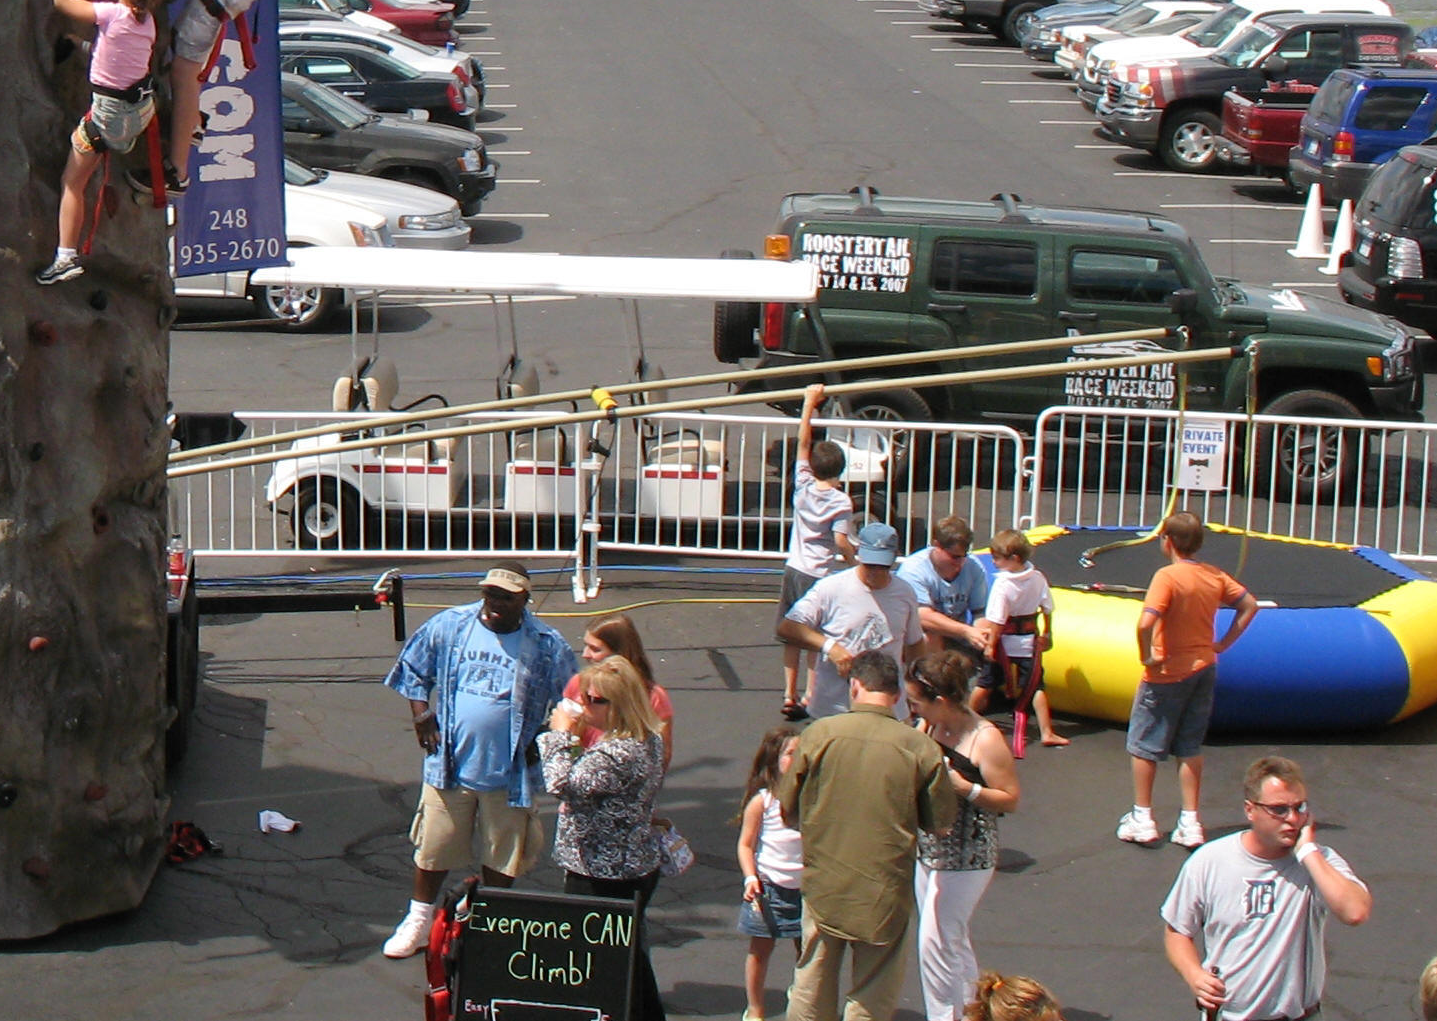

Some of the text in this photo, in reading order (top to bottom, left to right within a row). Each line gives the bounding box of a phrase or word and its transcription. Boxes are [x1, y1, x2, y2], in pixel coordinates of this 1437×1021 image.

[209, 207, 248, 231] 248
[179, 237, 279, 266] 935-2670
[802, 232, 911, 258] ROOSTERTAIL
[842, 255, 911, 277] WEEKEND
[880, 276, 909, 293] 2007
[1064, 377, 1175, 400] RACE WEEKEND
[1183, 429, 1224, 442] RIVATE
[1182, 442, 1218, 454] EVENT
[459, 649, 516, 673] SUMMI
[469, 902, 633, 951] Everyone CAN
[464, 998, 490, 1020] Easy
